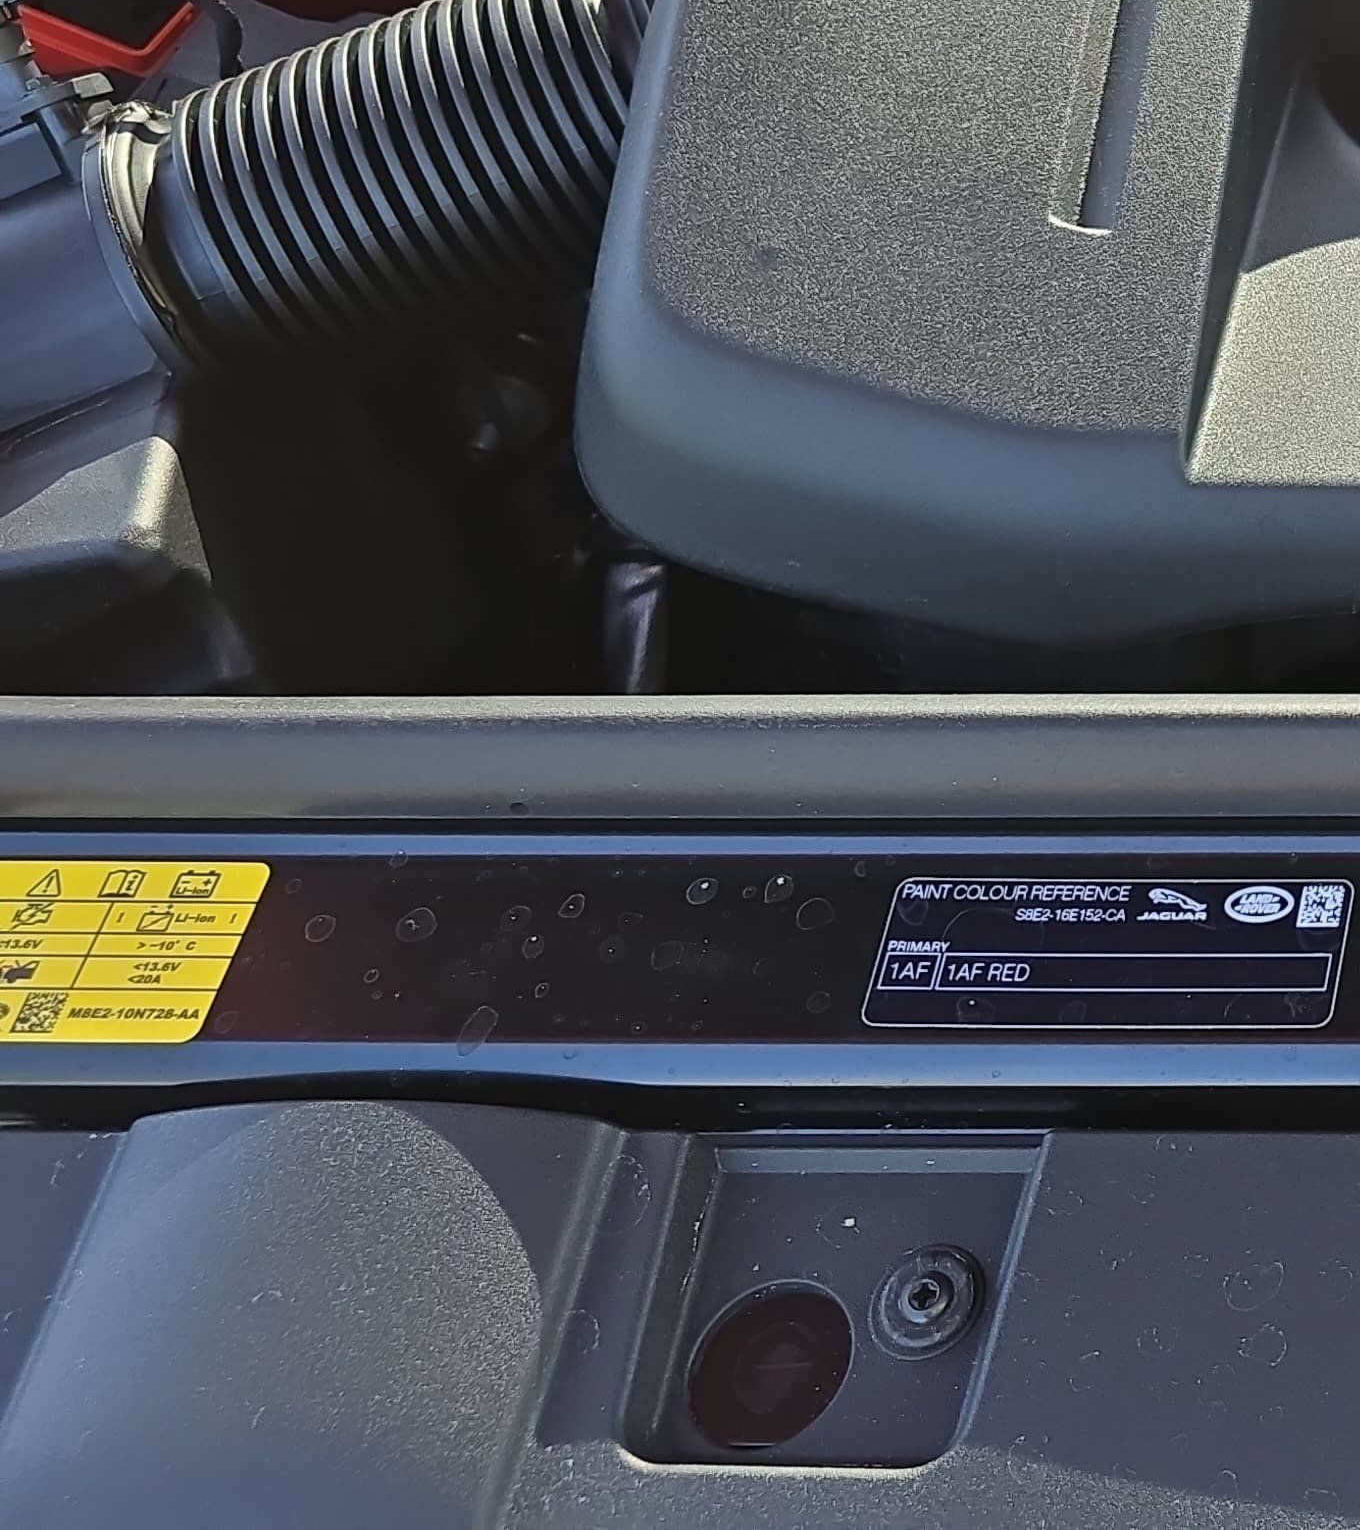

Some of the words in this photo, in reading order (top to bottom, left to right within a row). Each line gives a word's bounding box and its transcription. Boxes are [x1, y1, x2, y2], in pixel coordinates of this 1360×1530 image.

[902, 884, 953, 901] PAINT
[953, 884, 1030, 902] COLOUR
[1031, 885, 1132, 902] REFERENCE
[1240, 894, 1272, 903] LAND
[1241, 903, 1281, 914] ROVER
[174, 913, 217, 923] Li-ion
[1015, 907, 1126, 923] S8E2-16E152-CA
[1136, 912, 1208, 921] JAGUAR
[888, 941, 950, 953] PRIMARY
[133, 961, 182, 972] <13.6V
[889, 962, 931, 981] 1AF
[947, 962, 986, 982] 1AF
[987, 963, 1030, 982] RED
